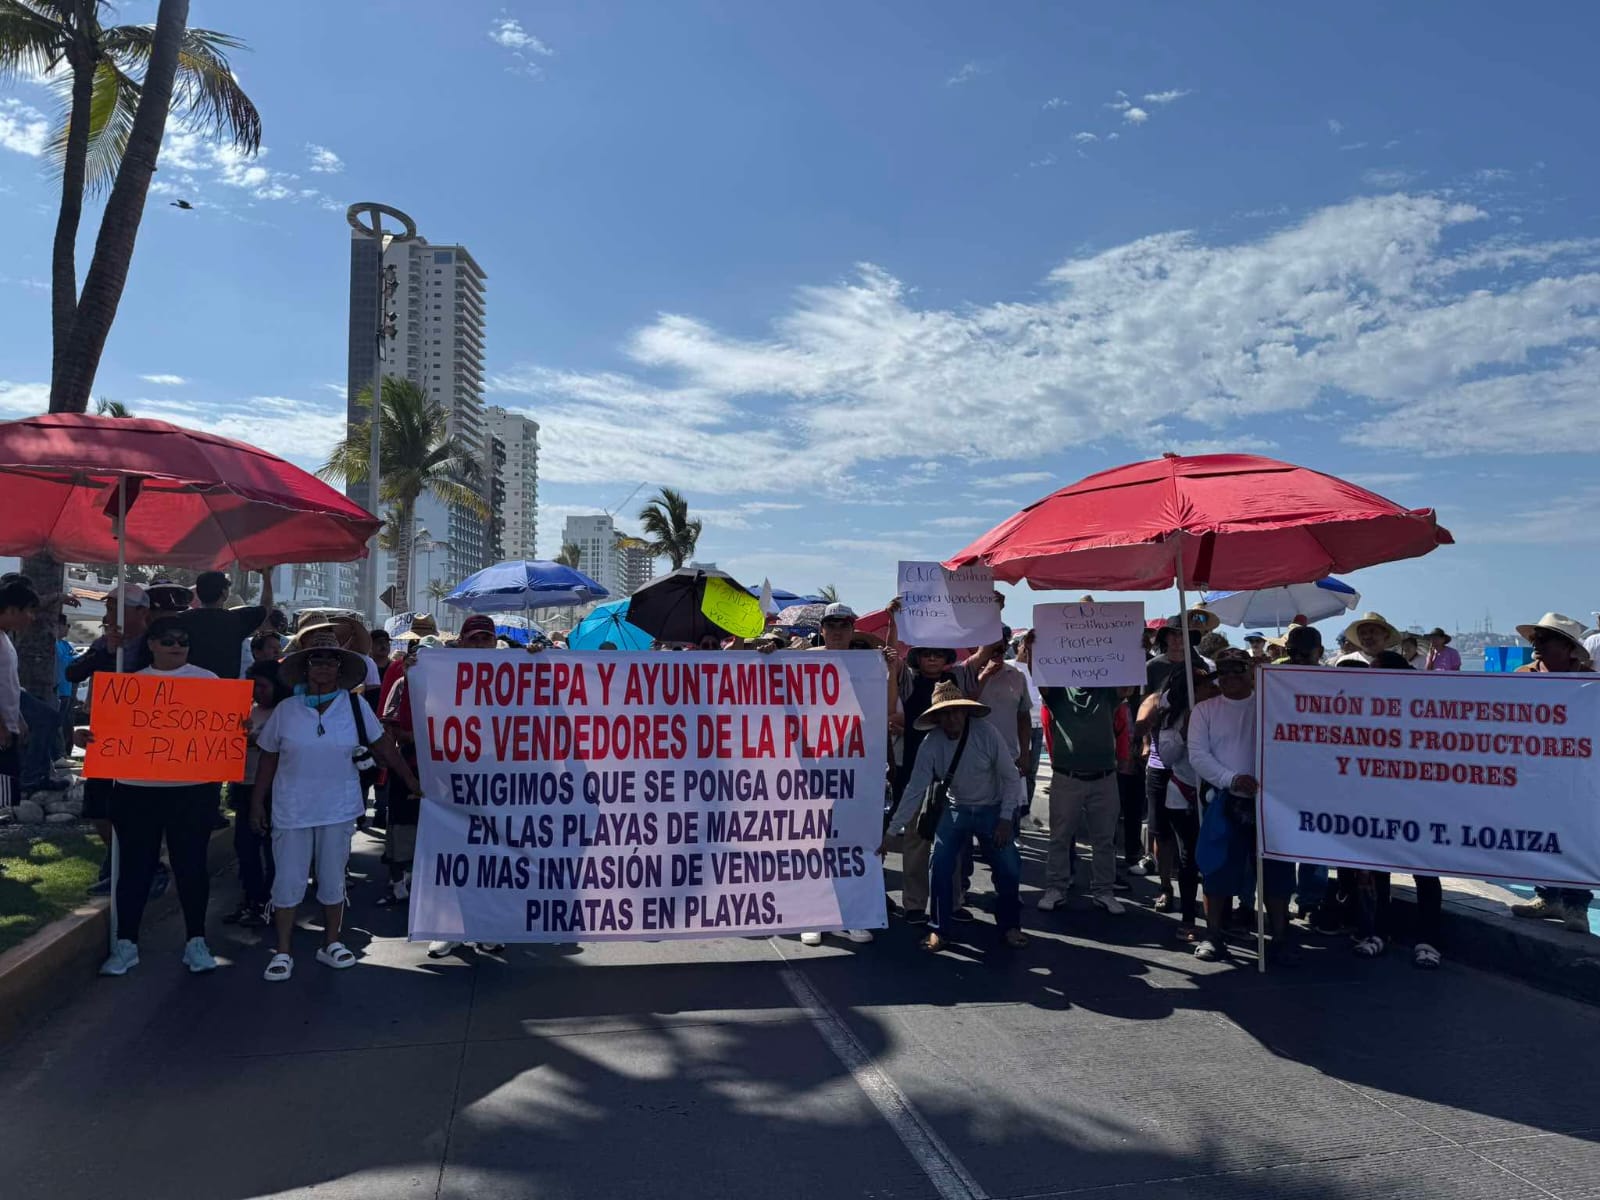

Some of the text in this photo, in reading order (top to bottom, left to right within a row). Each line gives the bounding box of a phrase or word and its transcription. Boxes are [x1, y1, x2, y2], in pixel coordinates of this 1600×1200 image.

[102, 677, 184, 706] NO AL
[455, 663, 840, 706] PROFEPA Y AYUNTAMIENTO
[132, 709, 249, 733] DESORDEN
[1294, 690, 1567, 725] UNIÓN DE CAMPESINOS
[100, 736, 245, 765] EN PLAYAS
[427, 715, 865, 762] LOS VENDEDORES DE LA PLAYA
[1273, 723, 1592, 758] ARTESANOS PRODUCTORES
[451, 769, 855, 806] EXIGIMOS QUE SE PONGA ORDEN
[1336, 757, 1518, 787] Y VENDEDORES
[467, 810, 839, 848] EN LAS PLAYAS DE MAZATLAN.
[1299, 811, 1562, 854] RODOLFO T. LOAIZA
[435, 846, 866, 890] NO MAS INVASIÓN DE VENDEDORES
[526, 891, 783, 932] PIRATAS EN PLAYAS.
